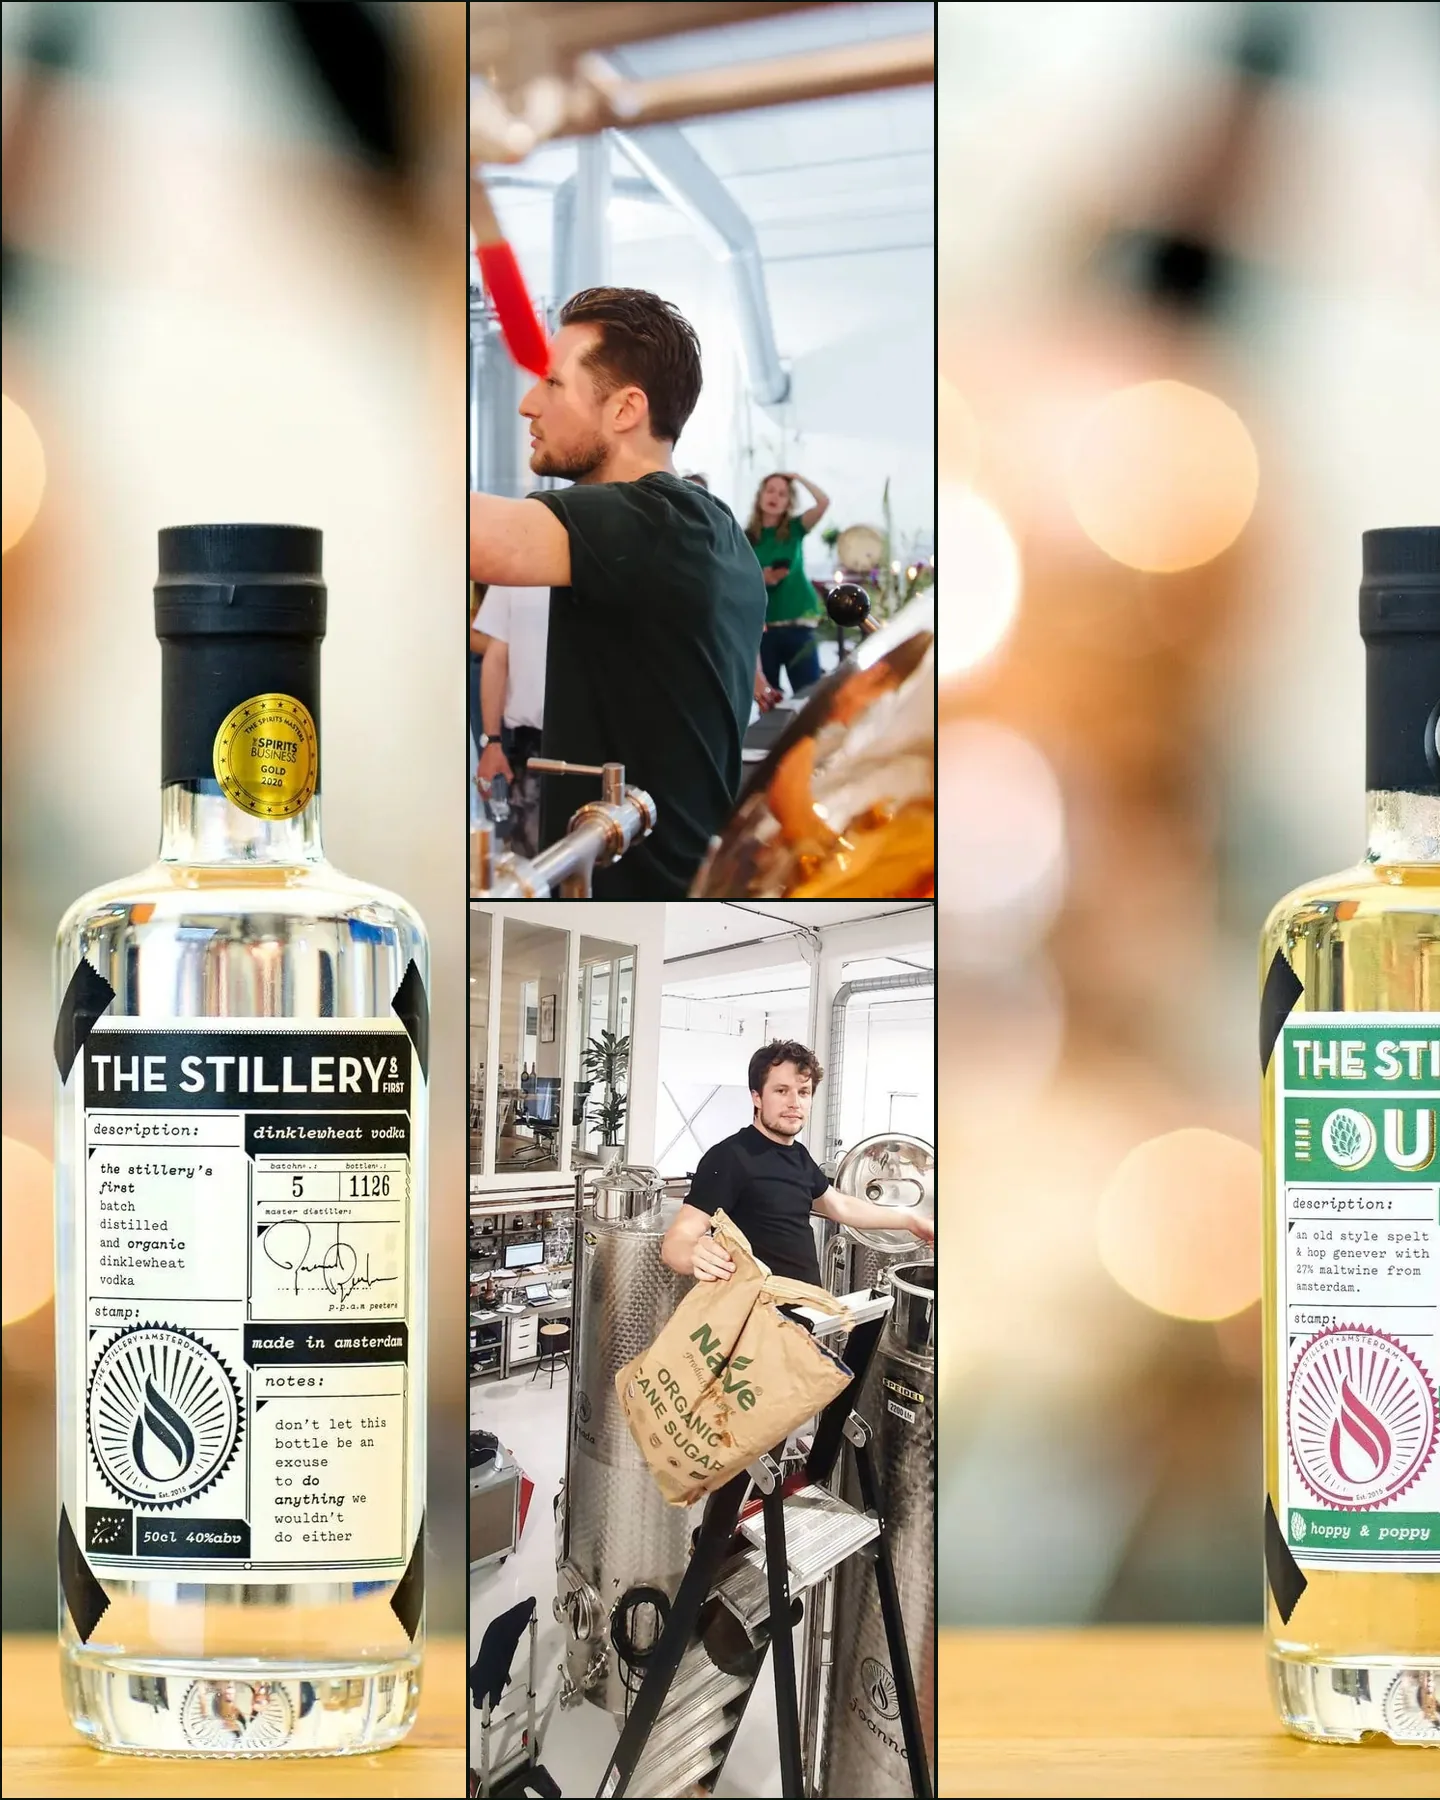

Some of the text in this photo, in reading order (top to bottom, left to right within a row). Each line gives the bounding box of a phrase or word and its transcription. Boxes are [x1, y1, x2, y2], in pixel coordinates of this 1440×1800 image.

[245, 716, 304, 742] THE SPIRITS MASTERS
[258, 738, 297, 752] SPIRITS
[251, 748, 296, 763] BUSINESS
[261, 765, 286, 775] GOLD
[261, 777, 282, 787] 2020
[1292, 1039, 1366, 1079] THE
[91, 1056, 167, 1092] THE
[382, 1082, 405, 1093] FIRST
[94, 1123, 199, 1137] description:
[253, 1126, 406, 1139] dinklewheat vodka
[100, 1164, 213, 1178] the stillery's
[99, 1182, 135, 1194] first
[292, 1176, 303, 1197] 5
[350, 1175, 390, 1197] 1126
[99, 1201, 136, 1212] batch
[1292, 1197, 1393, 1211] description:
[99, 1219, 168, 1231] distilled
[1296, 1230, 1429, 1243] an old style spelt
[100, 1238, 186, 1252] and organic
[1307, 1248, 1326, 1259] hop
[1332, 1249, 1386, 1261] genever
[1396, 1248, 1430, 1259] with
[99, 1256, 186, 1268] dinklewheat
[1296, 1264, 1421, 1276] 27% maltwine from
[100, 1274, 135, 1286] vodka
[1296, 1281, 1361, 1292] amsterdam.
[94, 1306, 139, 1319] stamp:
[1294, 1312, 1336, 1326] stamp:
[145, 1334, 203, 1357] AMSTERDAM
[252, 1336, 403, 1349] made in amsterdam
[265, 1376, 324, 1387] notes:
[883, 1378, 922, 1401] SPEIDEL
[658, 1368, 723, 1447] ORGANIC
[890, 1403, 904, 1417] 2200
[275, 1418, 387, 1430] don't let this
[275, 1437, 374, 1449] bottle be an
[275, 1458, 328, 1468] excuse
[275, 1475, 319, 1487] to do
[274, 1493, 367, 1506] anything we
[274, 1512, 344, 1524] wouldn't
[143, 1532, 242, 1544] 50cl 40%abv
[274, 1531, 352, 1542] do either
[1311, 1522, 1431, 1541] hoppy & poppy
